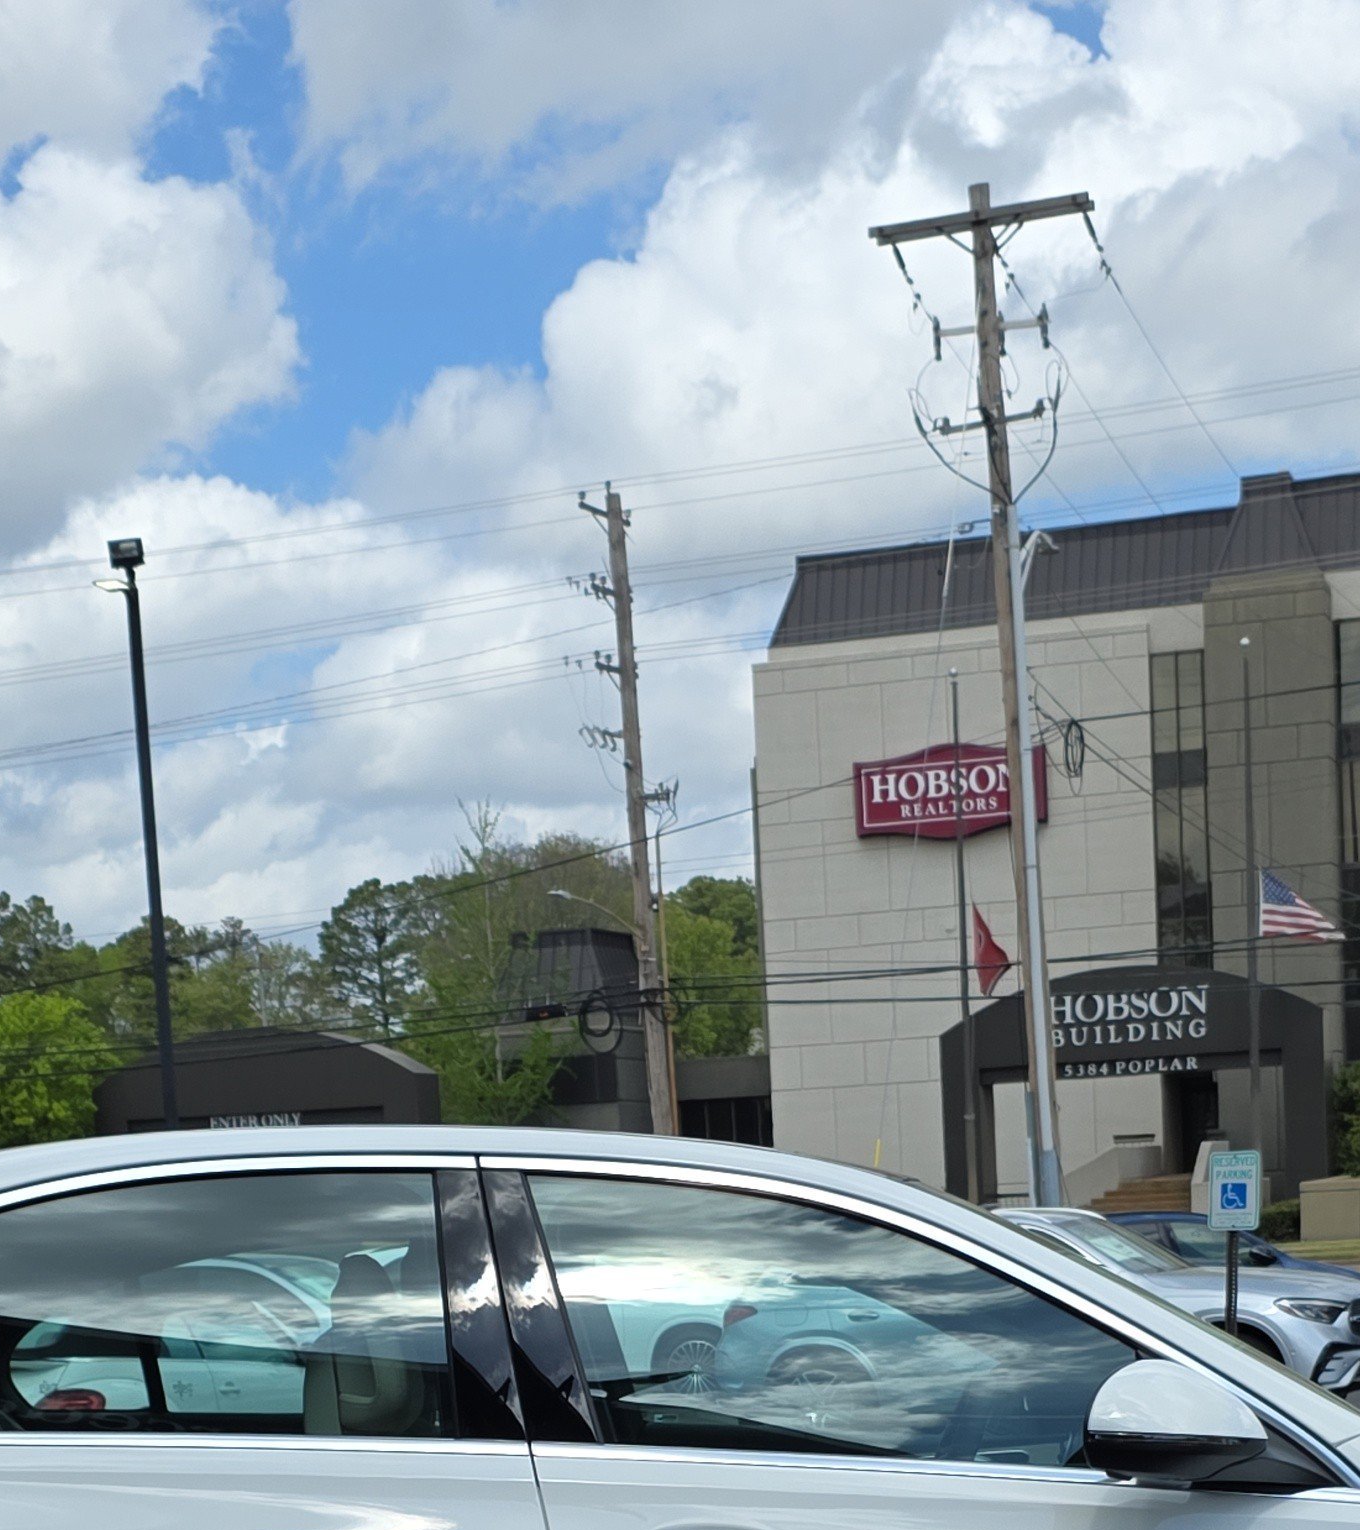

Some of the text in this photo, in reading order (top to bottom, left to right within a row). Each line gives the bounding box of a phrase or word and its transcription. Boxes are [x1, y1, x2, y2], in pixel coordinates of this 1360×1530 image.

[901, 797, 998, 818] REALTORS
[1051, 984, 1210, 1024] HOBSON
[1052, 1018, 1207, 1048] BUILDING
[1064, 1056, 1198, 1077] 5384 POPLAR
[210, 1112, 301, 1130] ENTER ONLY
[1214, 1156, 1255, 1167] RESERVED
[1215, 1169, 1252, 1179] PARKING
